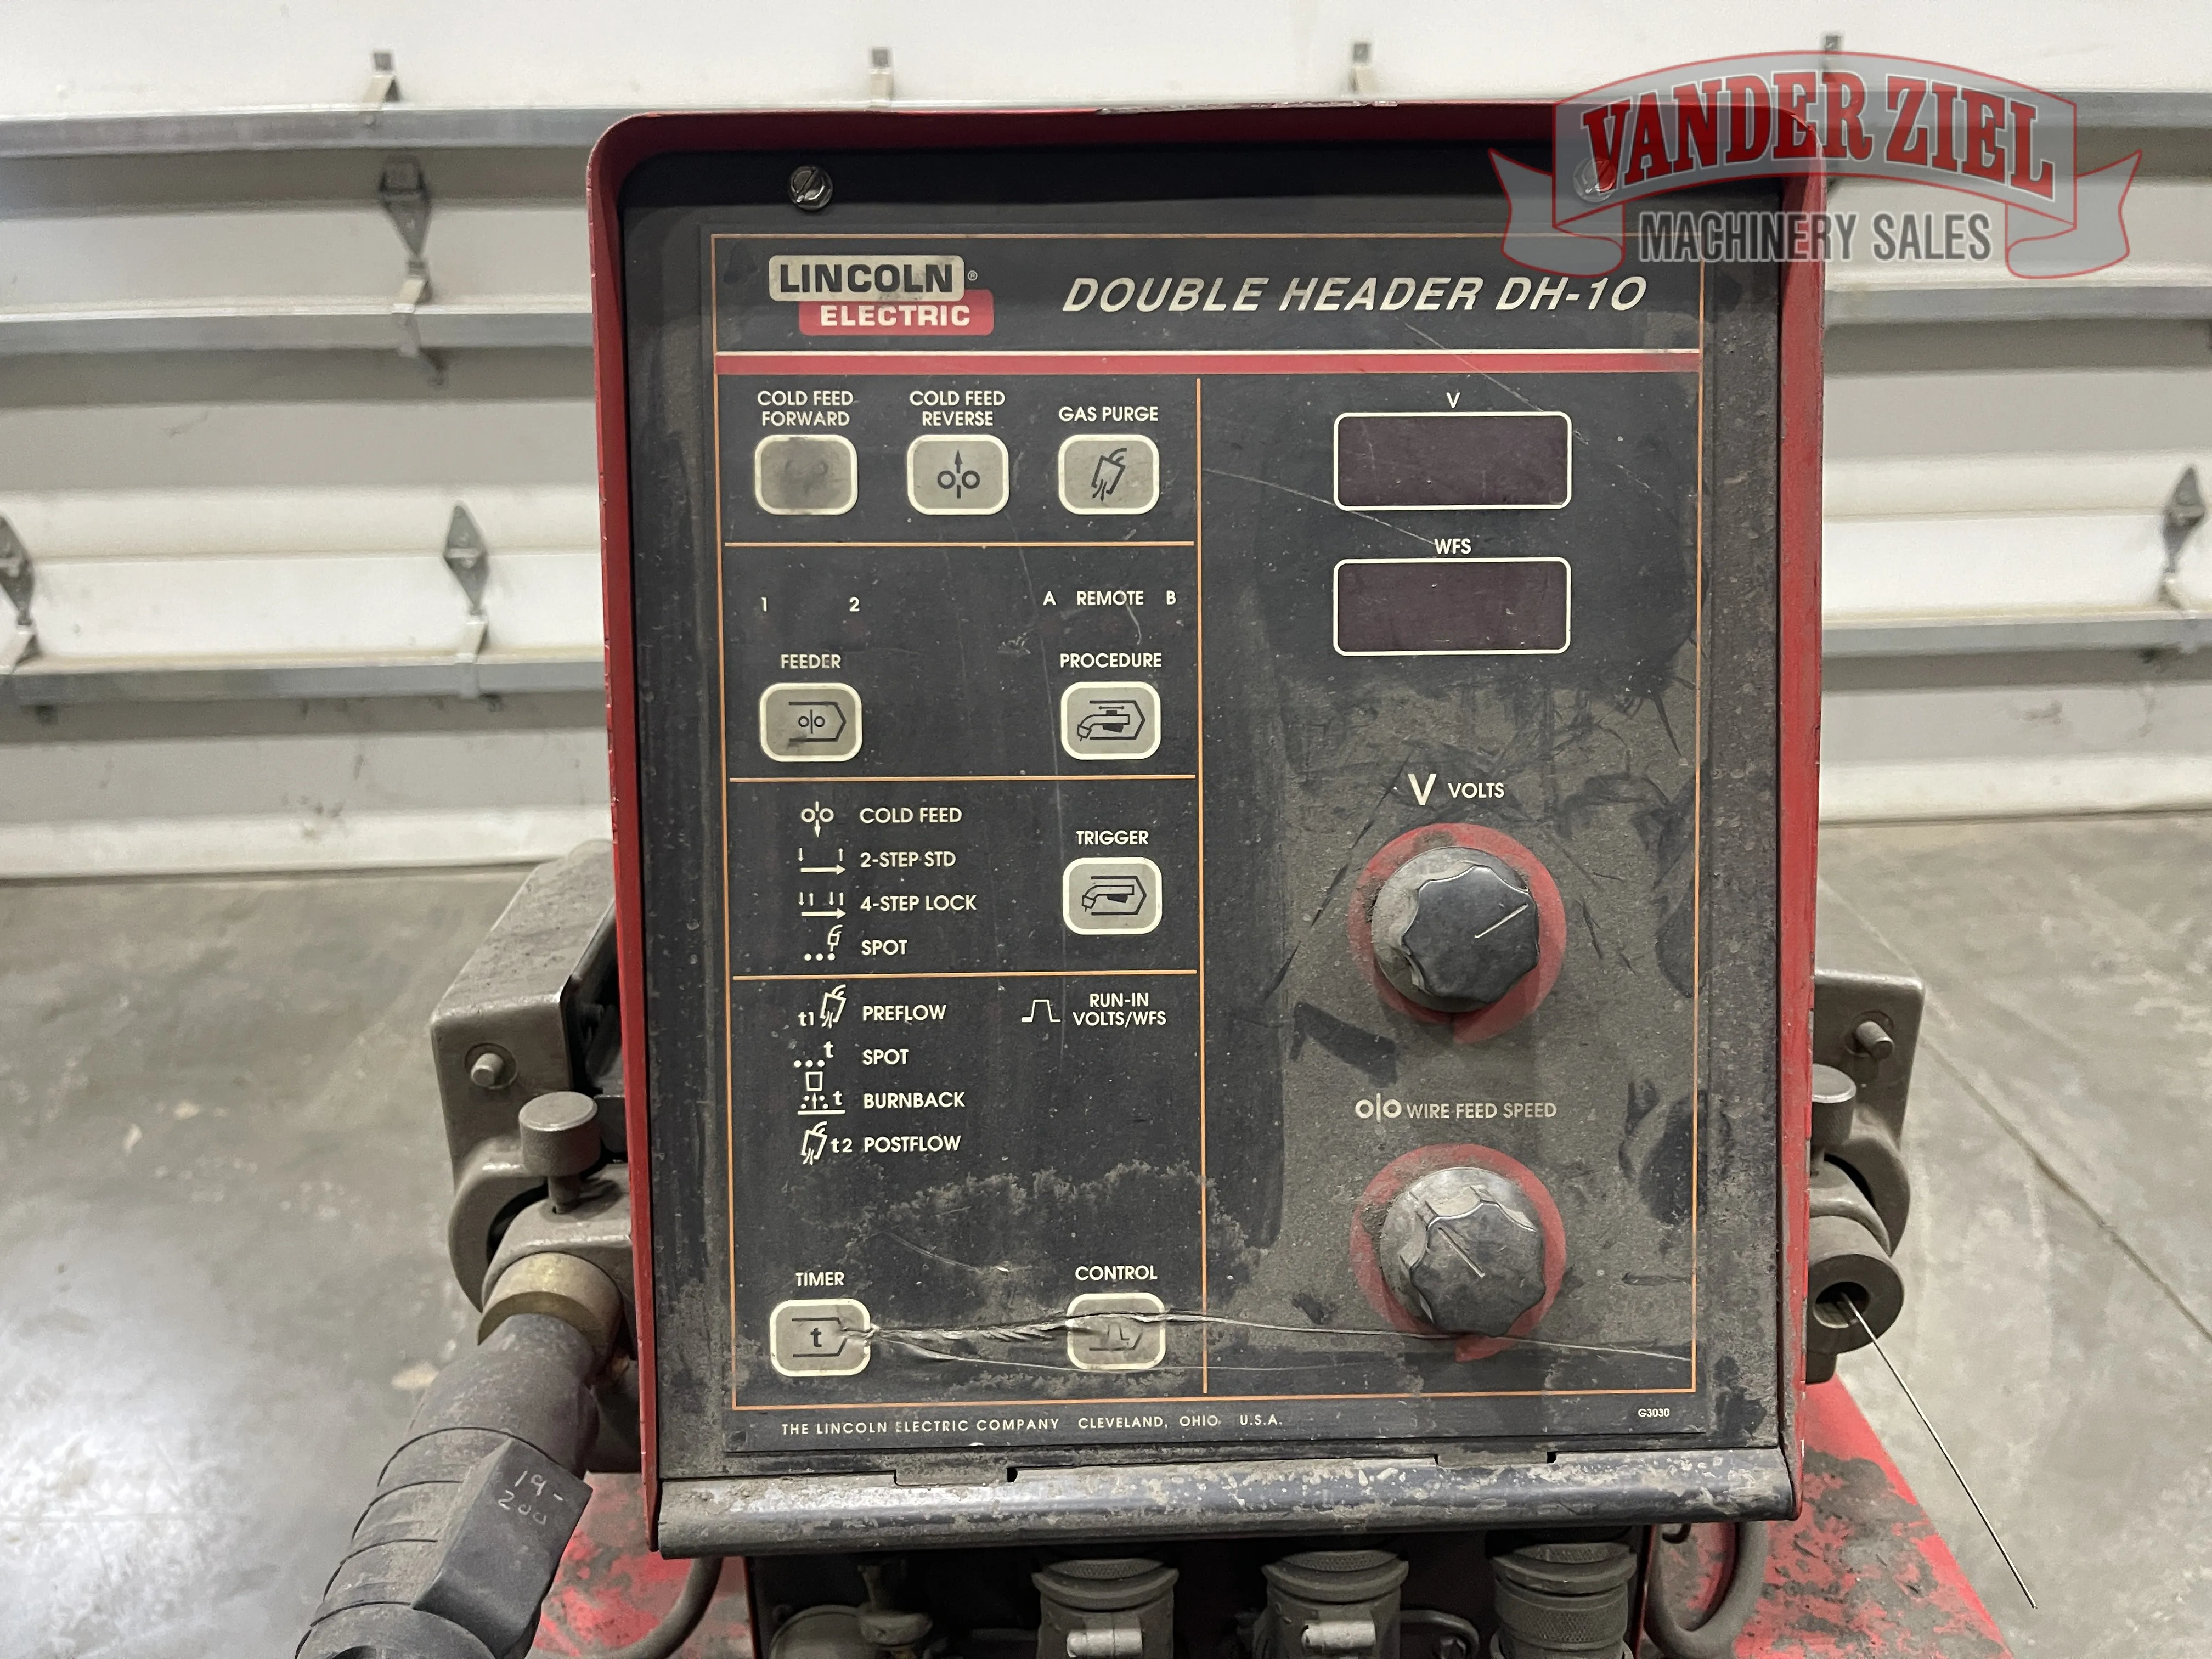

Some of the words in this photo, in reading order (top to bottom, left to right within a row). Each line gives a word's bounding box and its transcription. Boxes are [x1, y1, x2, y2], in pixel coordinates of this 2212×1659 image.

[780, 264, 953, 293] LINCOLN
[1062, 278, 1269, 312] DOUBLE
[1278, 277, 1480, 311] HEADER
[1495, 276, 1646, 311] DH-10
[821, 305, 970, 326] ELECTRIC
[757, 390, 808, 406] COLD
[814, 390, 854, 406] FEED
[910, 390, 960, 406] COLD
[966, 390, 1005, 406] FEED
[1446, 392, 1460, 408] V
[762, 411, 850, 426] FORWARD
[922, 411, 994, 426] REVERSE
[1059, 406, 1097, 422] GAS
[1102, 406, 1158, 421] PURGE
[1434, 538, 1472, 555] WFS
[761, 597, 767, 612] 1
[849, 596, 860, 612] 2
[1043, 591, 1057, 606] A
[1077, 590, 1144, 606] REMOTE
[1166, 590, 1176, 605] B
[781, 654, 841, 669] FEEDER
[1060, 652, 1162, 668] PROCEDURE
[1407, 773, 1437, 805] V
[1448, 782, 1504, 799] VOLTS
[860, 808, 913, 824] COLD
[919, 807, 962, 823] FEED
[1076, 830, 1149, 845] TRIGGER
[860, 851, 919, 868] 2-STEP
[924, 851, 956, 867] STD
[860, 895, 919, 912] 4-STEP
[926, 895, 977, 911] LOCK
[861, 939, 908, 956] SPOT
[1090, 992, 1149, 1008] RUN-IN
[862, 1005, 947, 1022] PREFLOW
[1073, 1011, 1166, 1028] VOLTS/WFS
[862, 1048, 909, 1065] SPOT
[864, 1091, 965, 1109] BURNBACK
[1406, 1103, 1449, 1119] WIRE
[1456, 1103, 1498, 1119] FEED
[1503, 1102, 1557, 1118] SPEED
[864, 1135, 961, 1153] POSTFLOW
[795, 1271, 845, 1286] TIMER
[1075, 1265, 1158, 1281] CONTROL
[810, 1327, 822, 1348] t
[1638, 1408, 1670, 1418] G3030
[782, 1423, 809, 1435] THE
[817, 1421, 887, 1434] LINCOLN
[895, 1420, 969, 1432] ELECTRIC
[976, 1418, 1059, 1431] COMPANY
[1078, 1416, 1168, 1429] CLEVELAND,
[1240, 1414, 1282, 1426] U.S.A.
